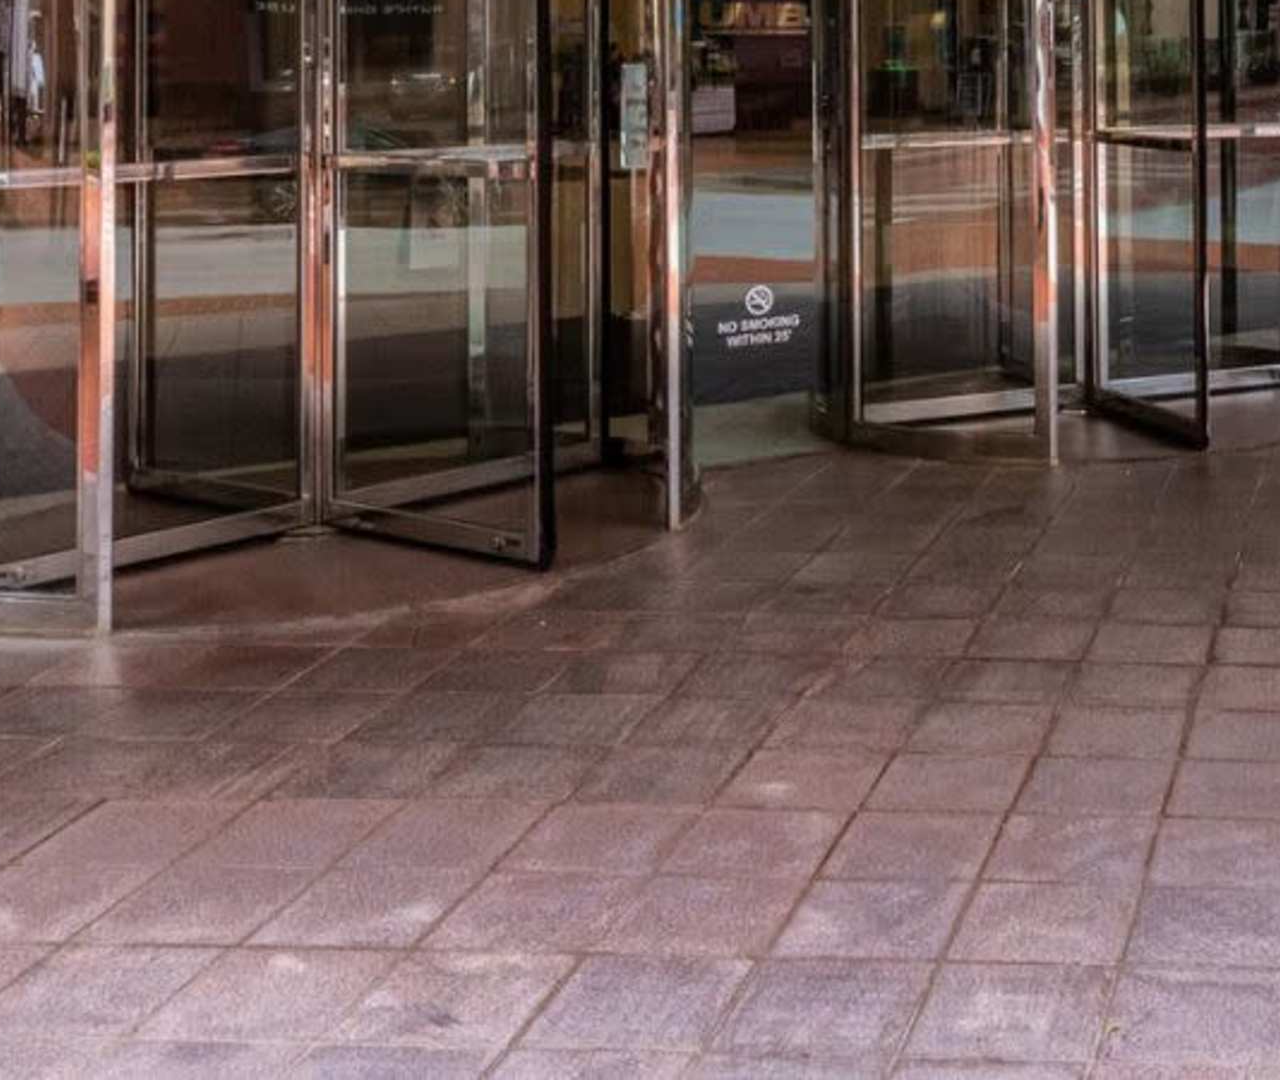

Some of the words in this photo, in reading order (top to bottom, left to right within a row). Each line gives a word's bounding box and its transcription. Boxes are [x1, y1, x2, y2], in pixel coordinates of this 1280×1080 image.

[718, 321, 738, 335] NO
[740, 314, 800, 332] SMOKING
[726, 332, 773, 348] WITHIN
